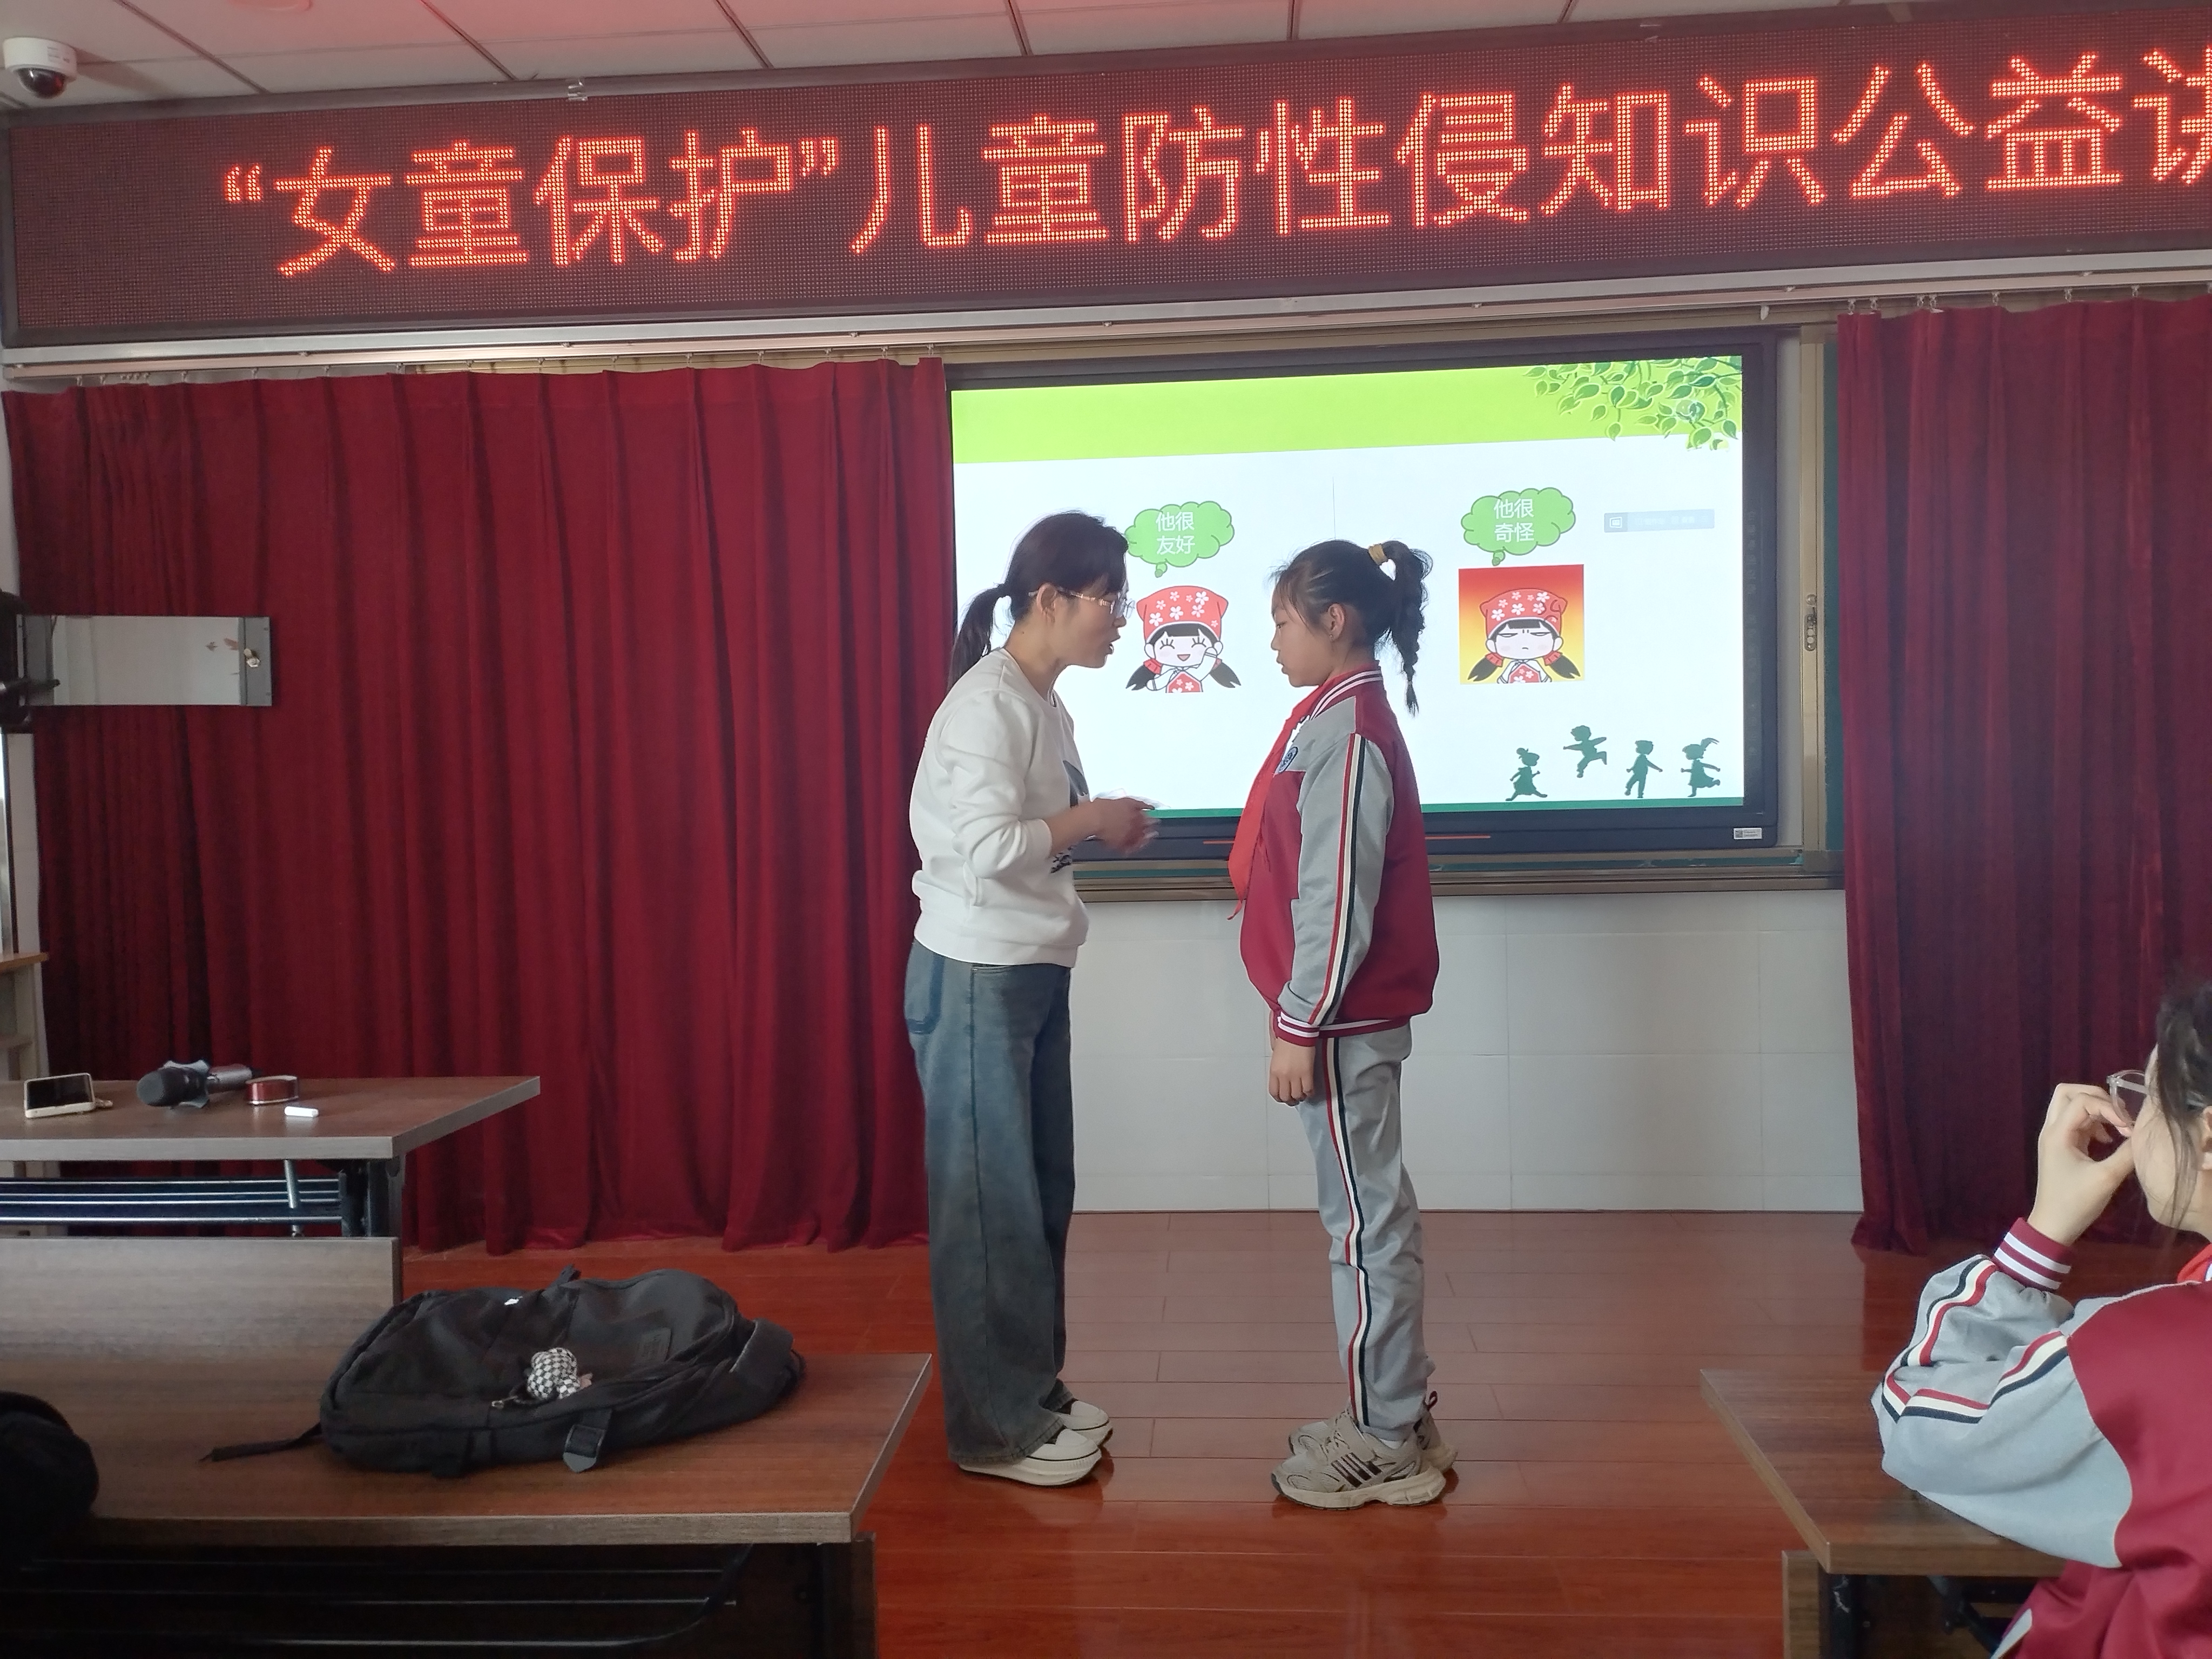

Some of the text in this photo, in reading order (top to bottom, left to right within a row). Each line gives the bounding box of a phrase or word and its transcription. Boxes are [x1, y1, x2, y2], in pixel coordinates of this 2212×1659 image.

[1494, 498, 1534, 519] 他很
[1156, 511, 1195, 531] 他很
[1495, 523, 1534, 543] 奇怪
[1156, 535, 1195, 555] 友好
